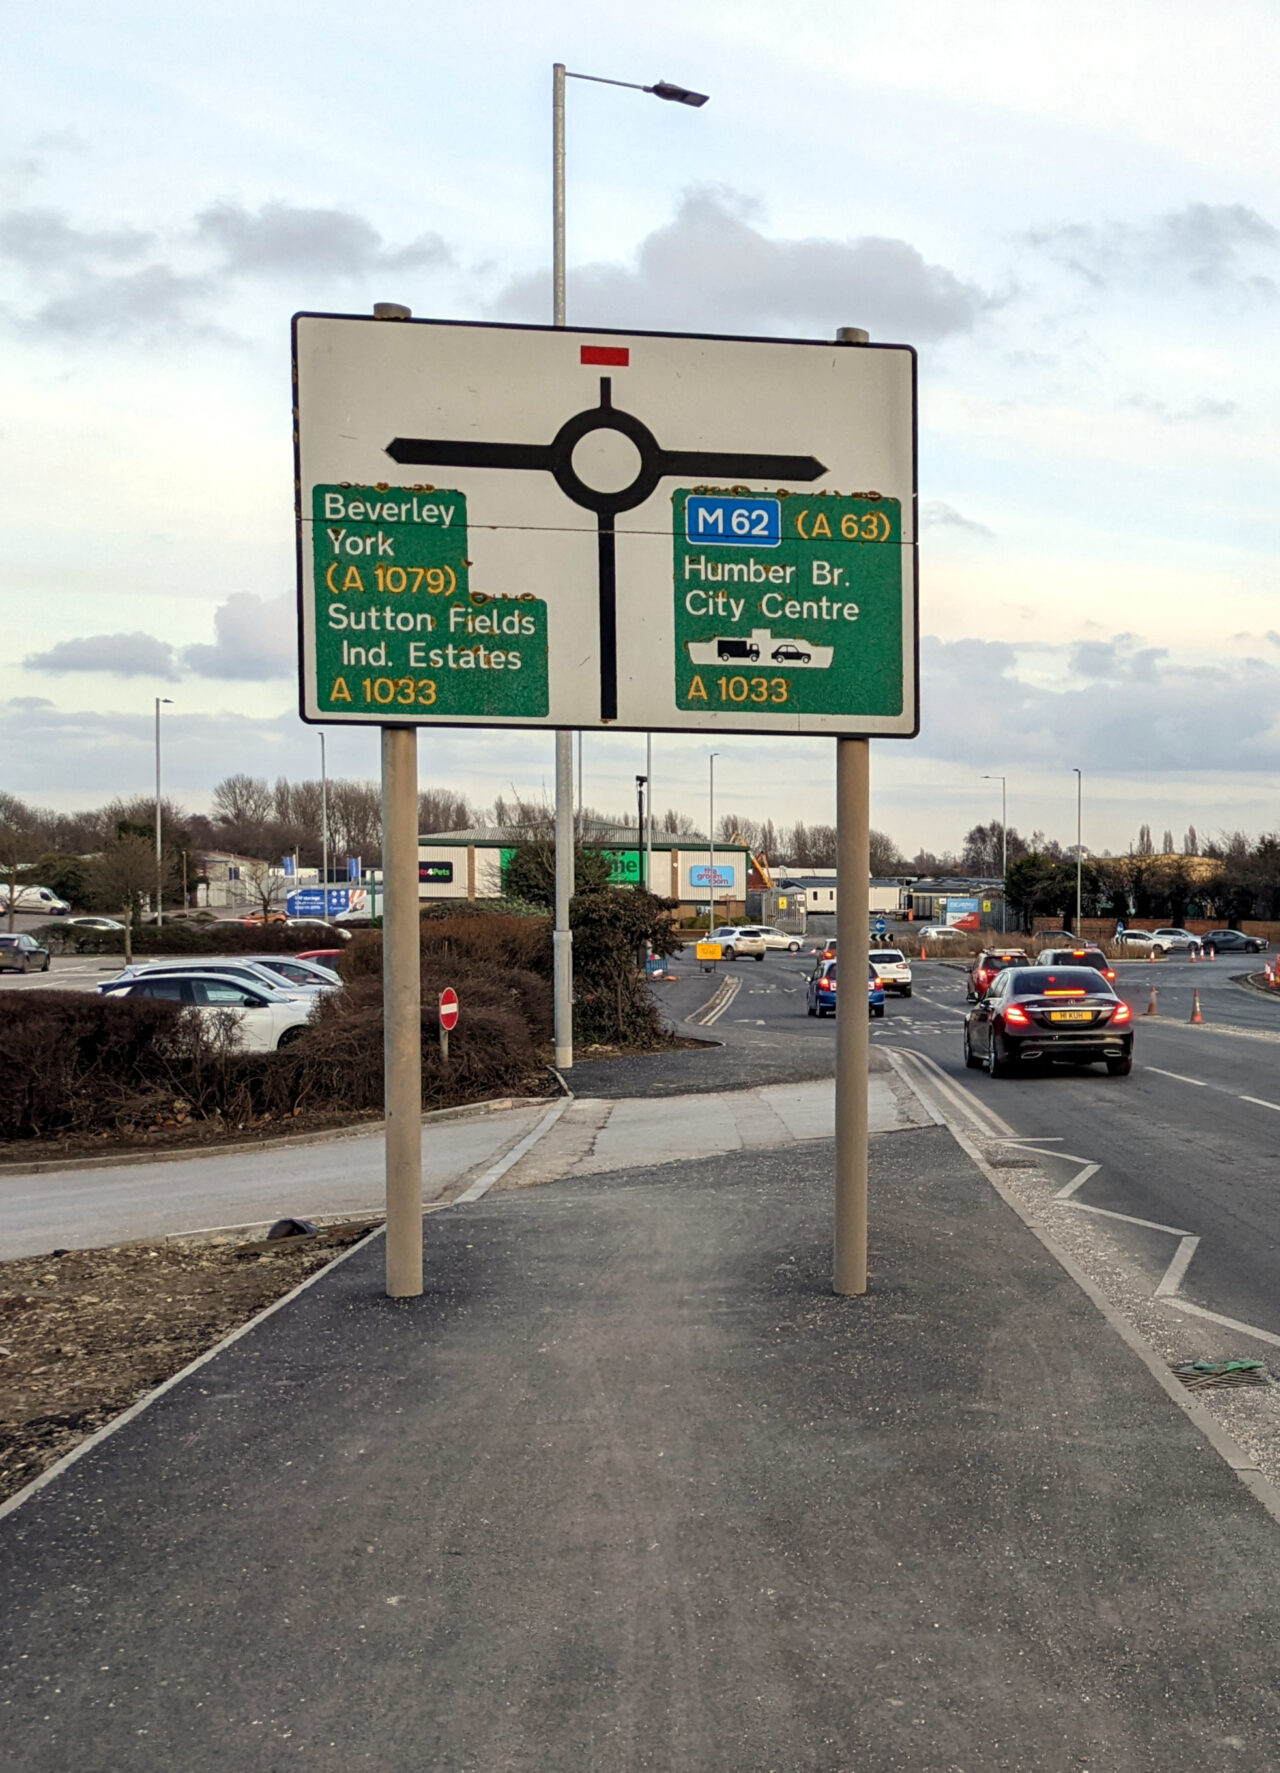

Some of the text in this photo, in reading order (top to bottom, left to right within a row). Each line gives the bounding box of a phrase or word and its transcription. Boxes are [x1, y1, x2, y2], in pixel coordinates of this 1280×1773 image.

[324, 492, 455, 529] Beverley
[697, 507, 769, 536] M 62
[796, 509, 891, 542] (A 63)
[326, 528, 395, 556] York
[326, 561, 457, 597] (A 1079)
[684, 554, 850, 587] Humber Br.
[327, 602, 536, 635] Sutton Fields
[685, 589, 860, 622] City Centre
[342, 639, 522, 670] Ind. Estates
[329, 676, 437, 705] A 1033
[687, 674, 788, 703] A 1033
